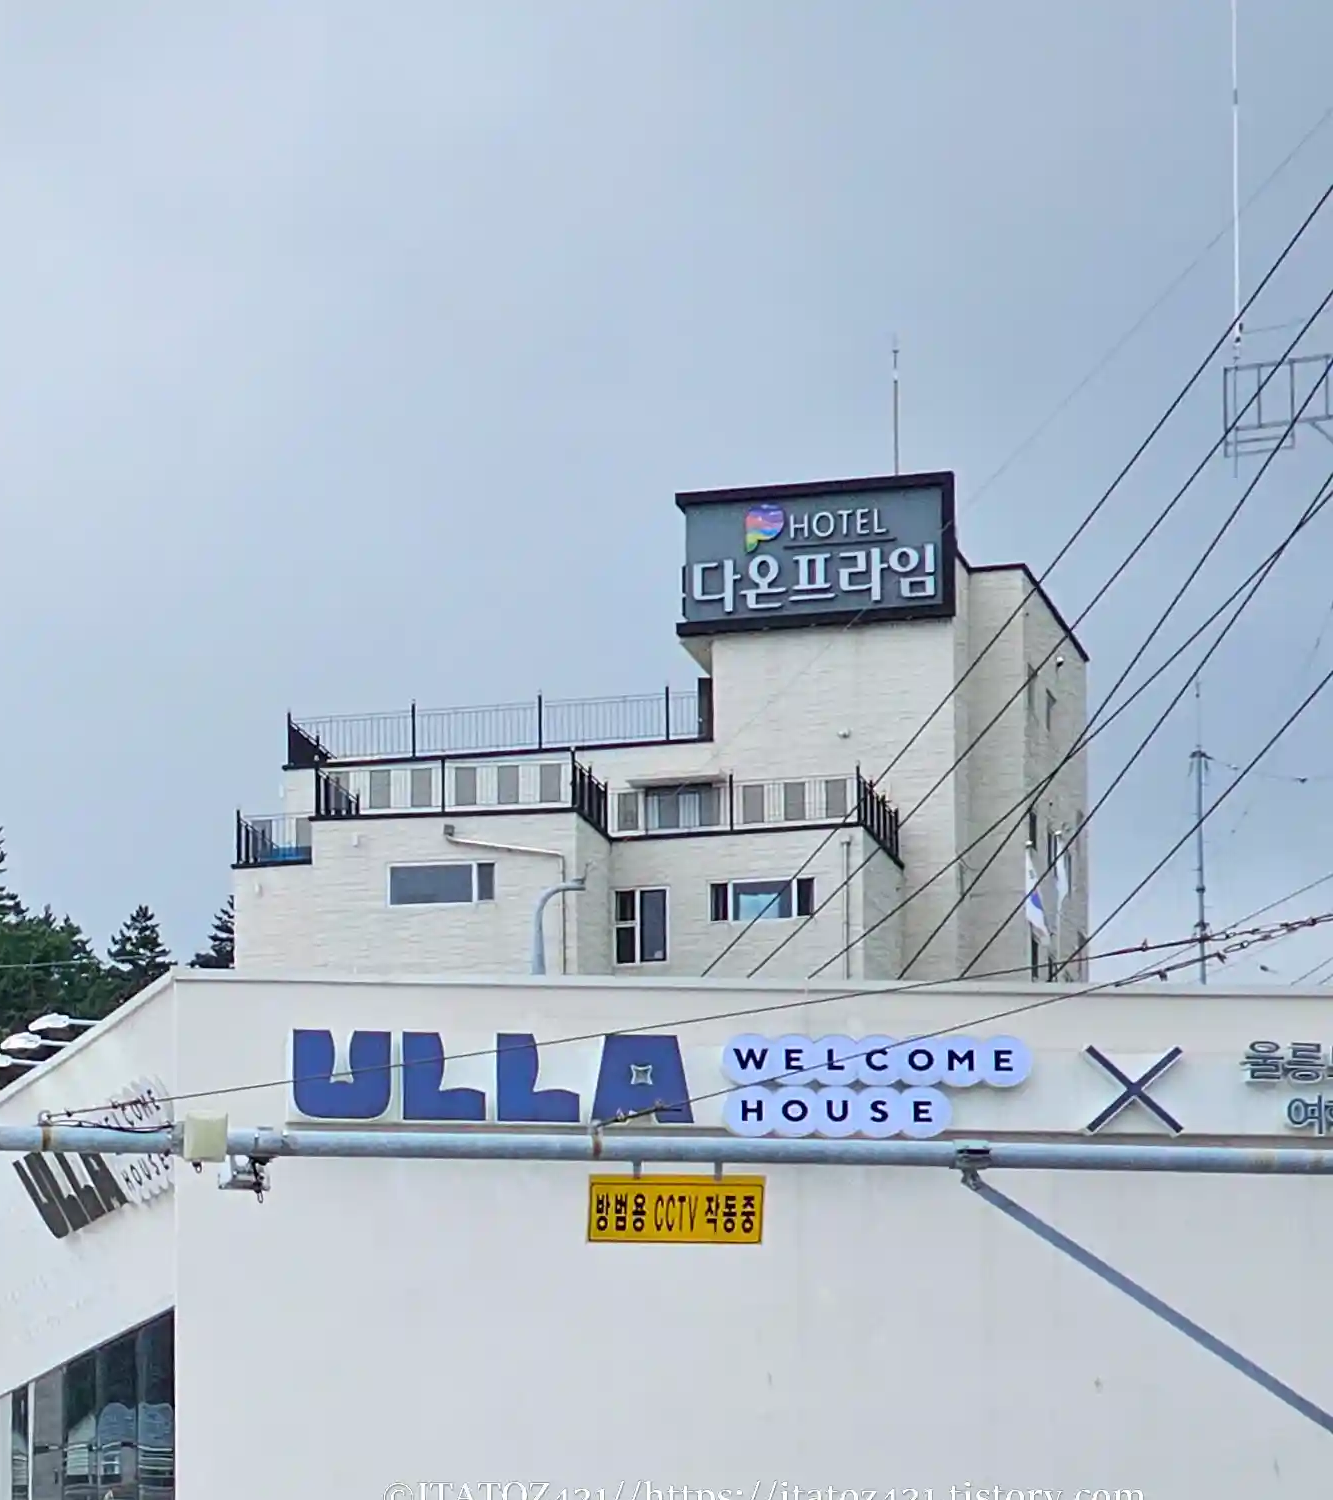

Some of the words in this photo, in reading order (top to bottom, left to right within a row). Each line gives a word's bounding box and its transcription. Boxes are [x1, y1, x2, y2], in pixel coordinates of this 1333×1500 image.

[789, 507, 888, 539] HOTEL
[692, 543, 937, 613] 다온프라임
[290, 1029, 695, 1125] ULLA
[732, 1045, 1016, 1076] WELCOME
[1244, 1040, 1333, 1081] 울릉
[740, 1099, 935, 1124] HOUSE
[1287, 1094, 1333, 1136] 여
[596, 1192, 646, 1232] 방범용
[654, 1194, 698, 1232] CCTV
[705, 1194, 755, 1235] 작동중
